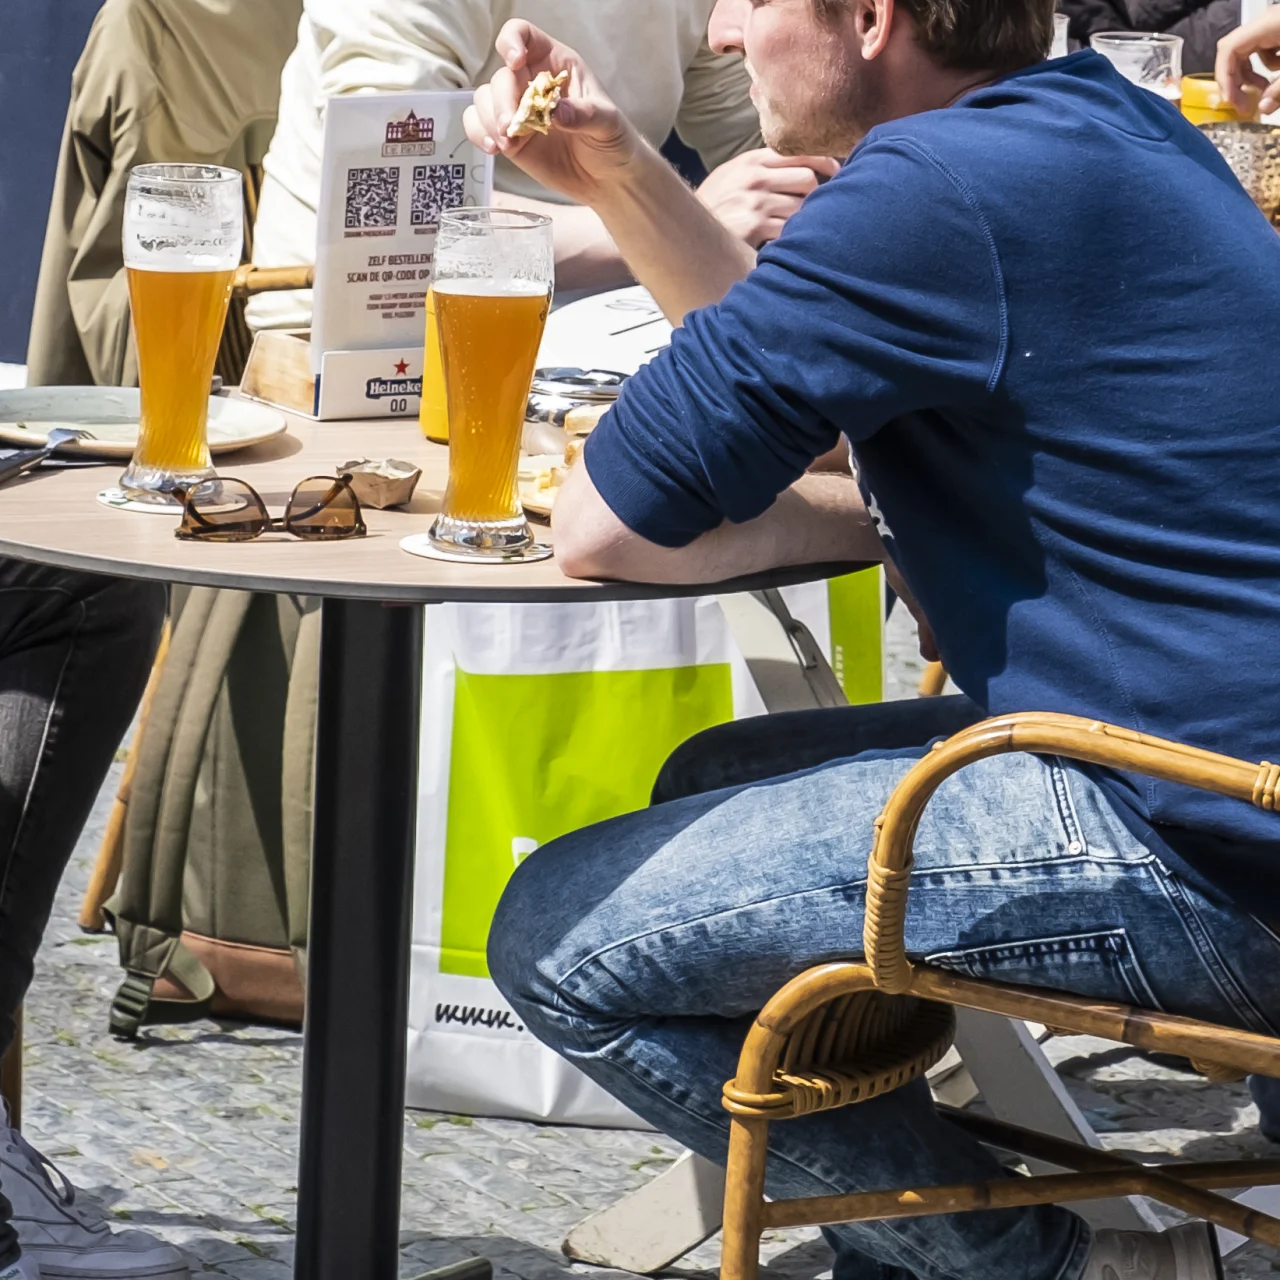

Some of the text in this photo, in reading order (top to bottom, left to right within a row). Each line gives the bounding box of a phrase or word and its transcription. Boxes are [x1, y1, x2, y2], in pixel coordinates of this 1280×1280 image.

[368, 255, 387, 267] ZELF
[346, 269, 430, 283] SCAN DE QR-CODE OP
[369, 380, 422, 395] Heineke
[435, 1003, 525, 1032] www.
